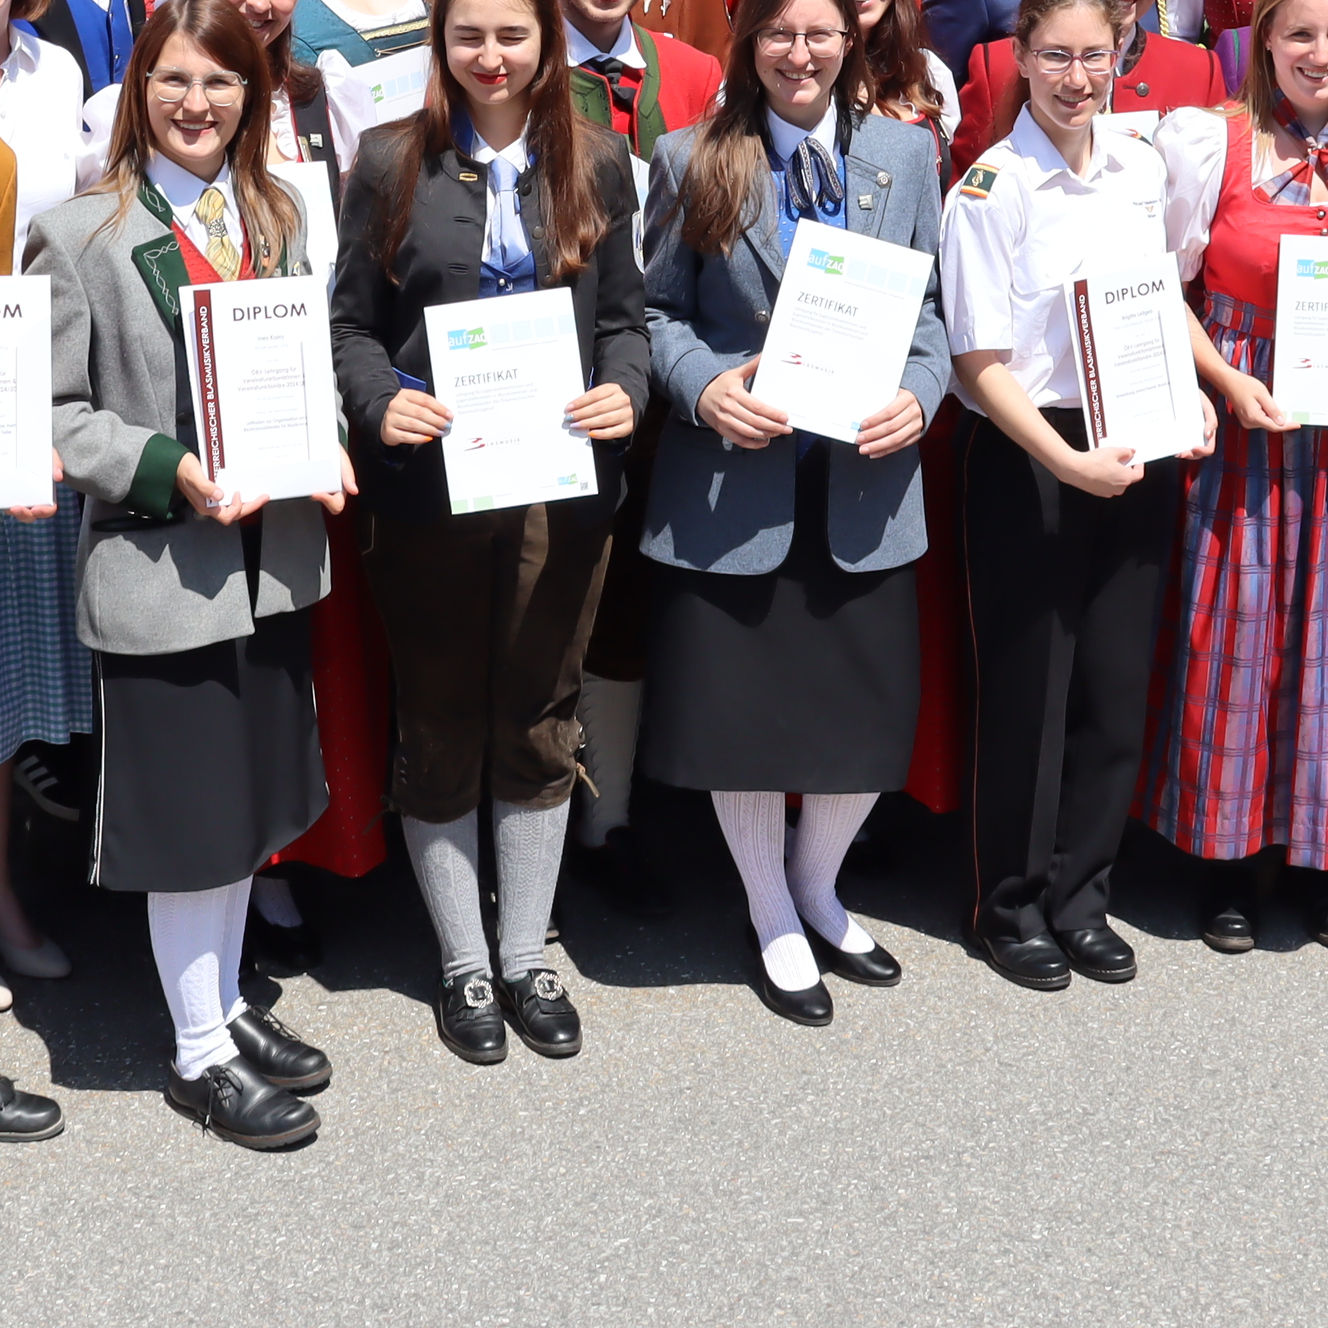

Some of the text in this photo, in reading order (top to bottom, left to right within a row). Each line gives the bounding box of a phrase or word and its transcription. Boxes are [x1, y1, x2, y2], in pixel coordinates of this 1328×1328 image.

[797, 291, 859, 317] ZERTIFIKAT
[1105, 279, 1165, 305] DIPLOM
[232, 302, 308, 322] DIPLOM
[448, 330, 488, 348] aufZAQ
[1079, 294, 1096, 379] BLASMUSIKVERBAND
[199, 306, 215, 400] BLASMUSIKVERBAND
[454, 368, 518, 388] ZERTIFIKAT
